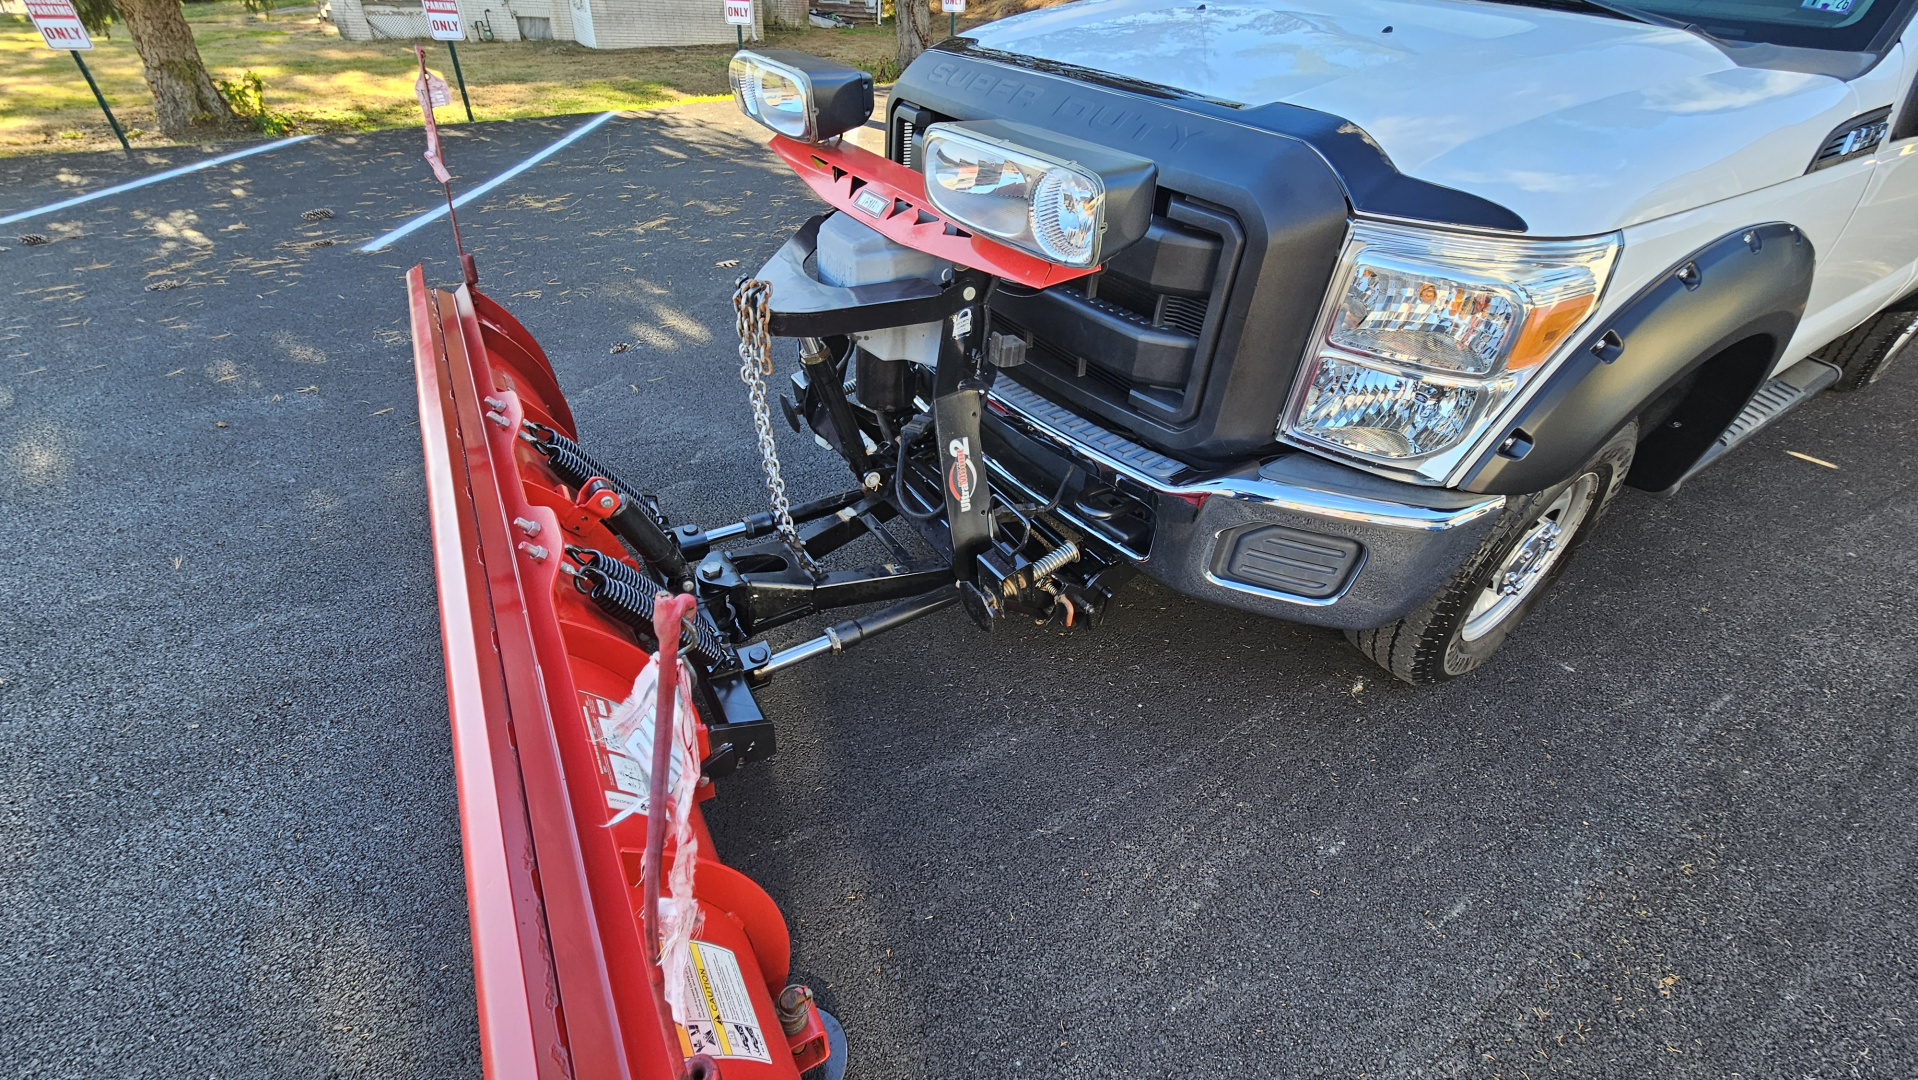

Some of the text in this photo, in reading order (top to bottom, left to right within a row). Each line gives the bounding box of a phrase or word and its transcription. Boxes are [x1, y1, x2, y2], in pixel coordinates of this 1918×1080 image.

[28, 5, 74, 16] PARKING
[425, 1, 457, 11] PARKING
[728, 7, 748, 17] ONLY
[432, 20, 458, 31] ONLY
[43, 27, 82, 40] ONLY
[927, 63, 1204, 152] SUPER DUTY
[699, 968, 718, 1012] CAUTION
